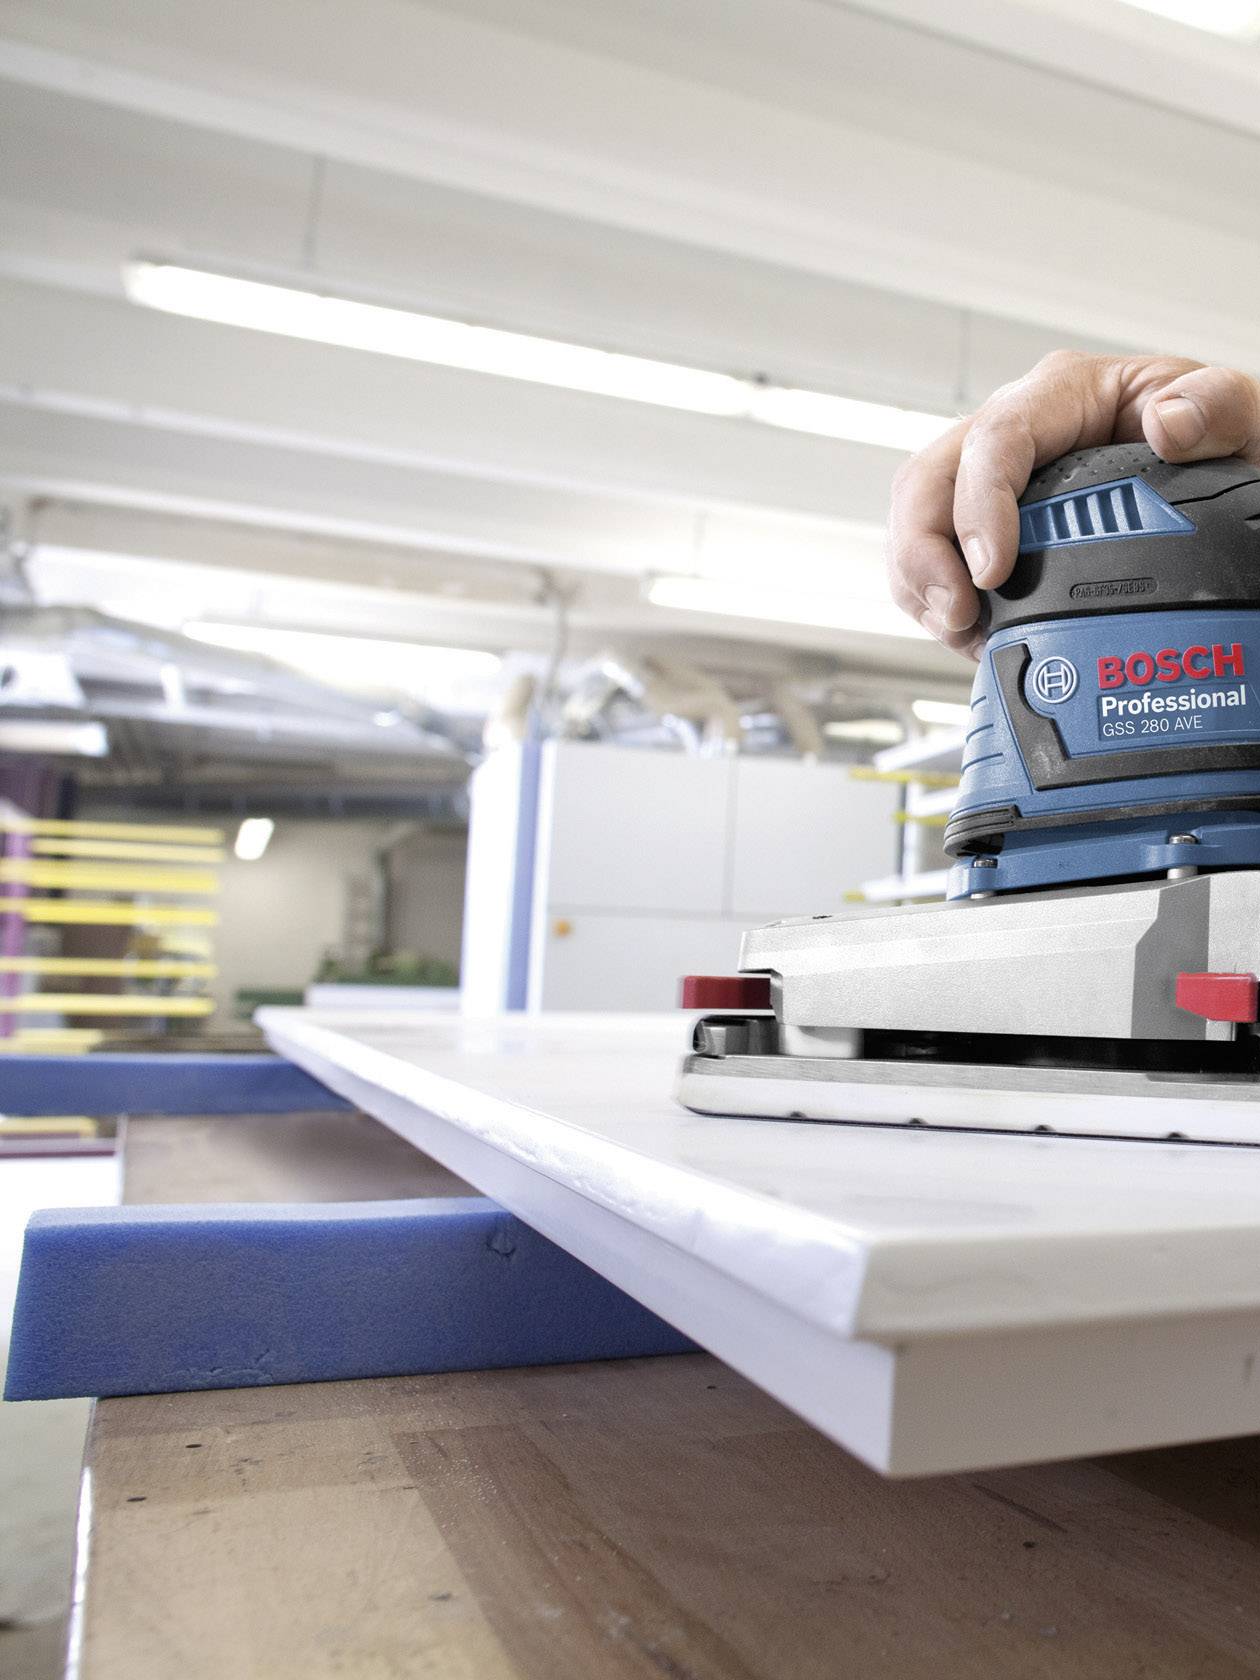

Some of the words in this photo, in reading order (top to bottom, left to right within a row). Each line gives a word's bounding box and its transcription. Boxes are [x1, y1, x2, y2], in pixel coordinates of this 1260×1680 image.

[1096, 642, 1246, 690] BOSCH
[1101, 684, 1247, 717] Professional
[1102, 720, 1136, 737] GSS
[1140, 718, 1170, 733] 280
[1174, 714, 1203, 731] AVE
